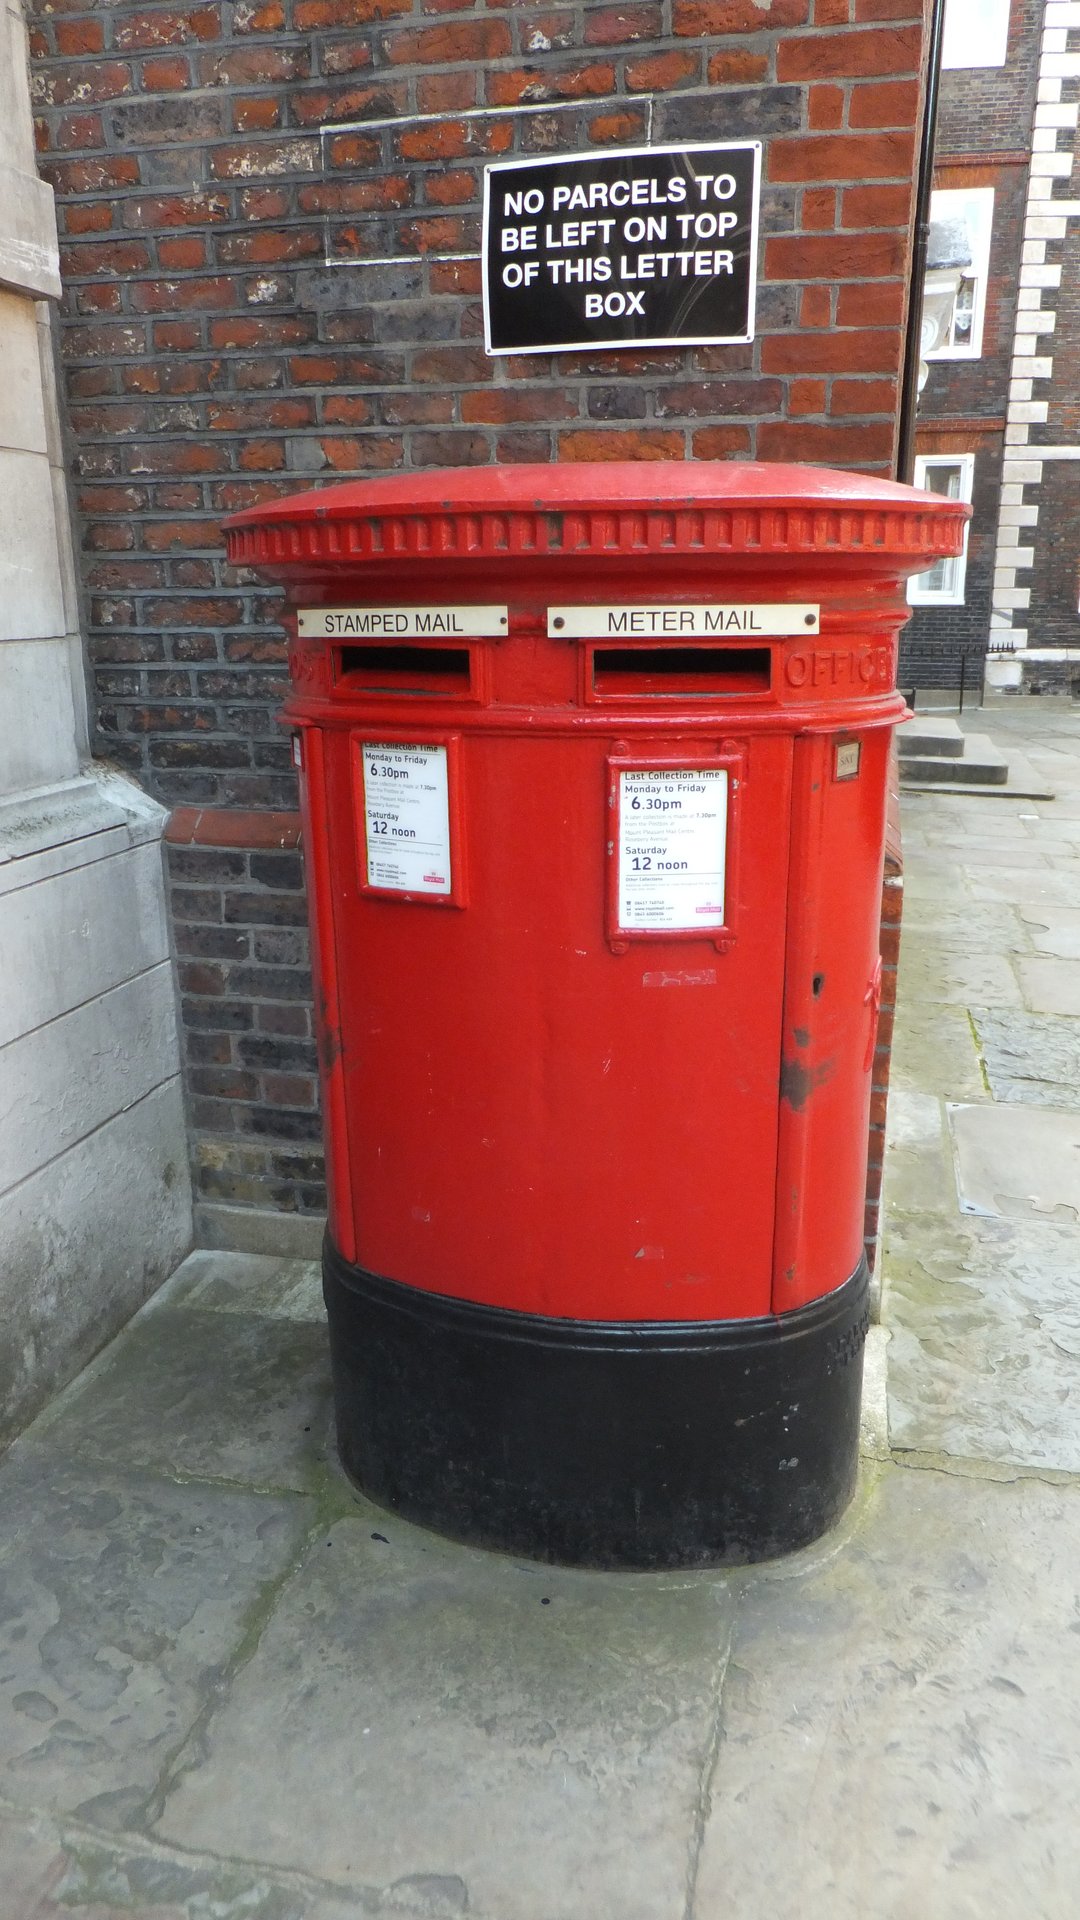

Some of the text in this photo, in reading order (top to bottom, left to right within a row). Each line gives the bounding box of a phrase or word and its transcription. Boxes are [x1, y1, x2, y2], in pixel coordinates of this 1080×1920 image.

[504, 175, 737, 216] NO PARCELS TO
[501, 212, 738, 252] BE LEFT ON TOP
[502, 250, 734, 288] OF THIS LETTER
[585, 291, 645, 318] BOX
[325, 613, 463, 633] STAMPED MAIL
[608, 610, 762, 632] METER MAIL
[366, 752, 392, 763] Monday
[404, 755, 428, 766] Friday
[370, 763, 408, 779] 6.30pm
[625, 770, 720, 780] Last Collection Time
[625, 784, 661, 794] Monday
[678, 784, 706, 794] Friday
[632, 796, 682, 811] 6.30pm
[368, 810, 399, 822] Saturday
[372, 820, 416, 838] 12 noon
[626, 846, 668, 856] Saturday
[632, 856, 688, 870] 12 noon
